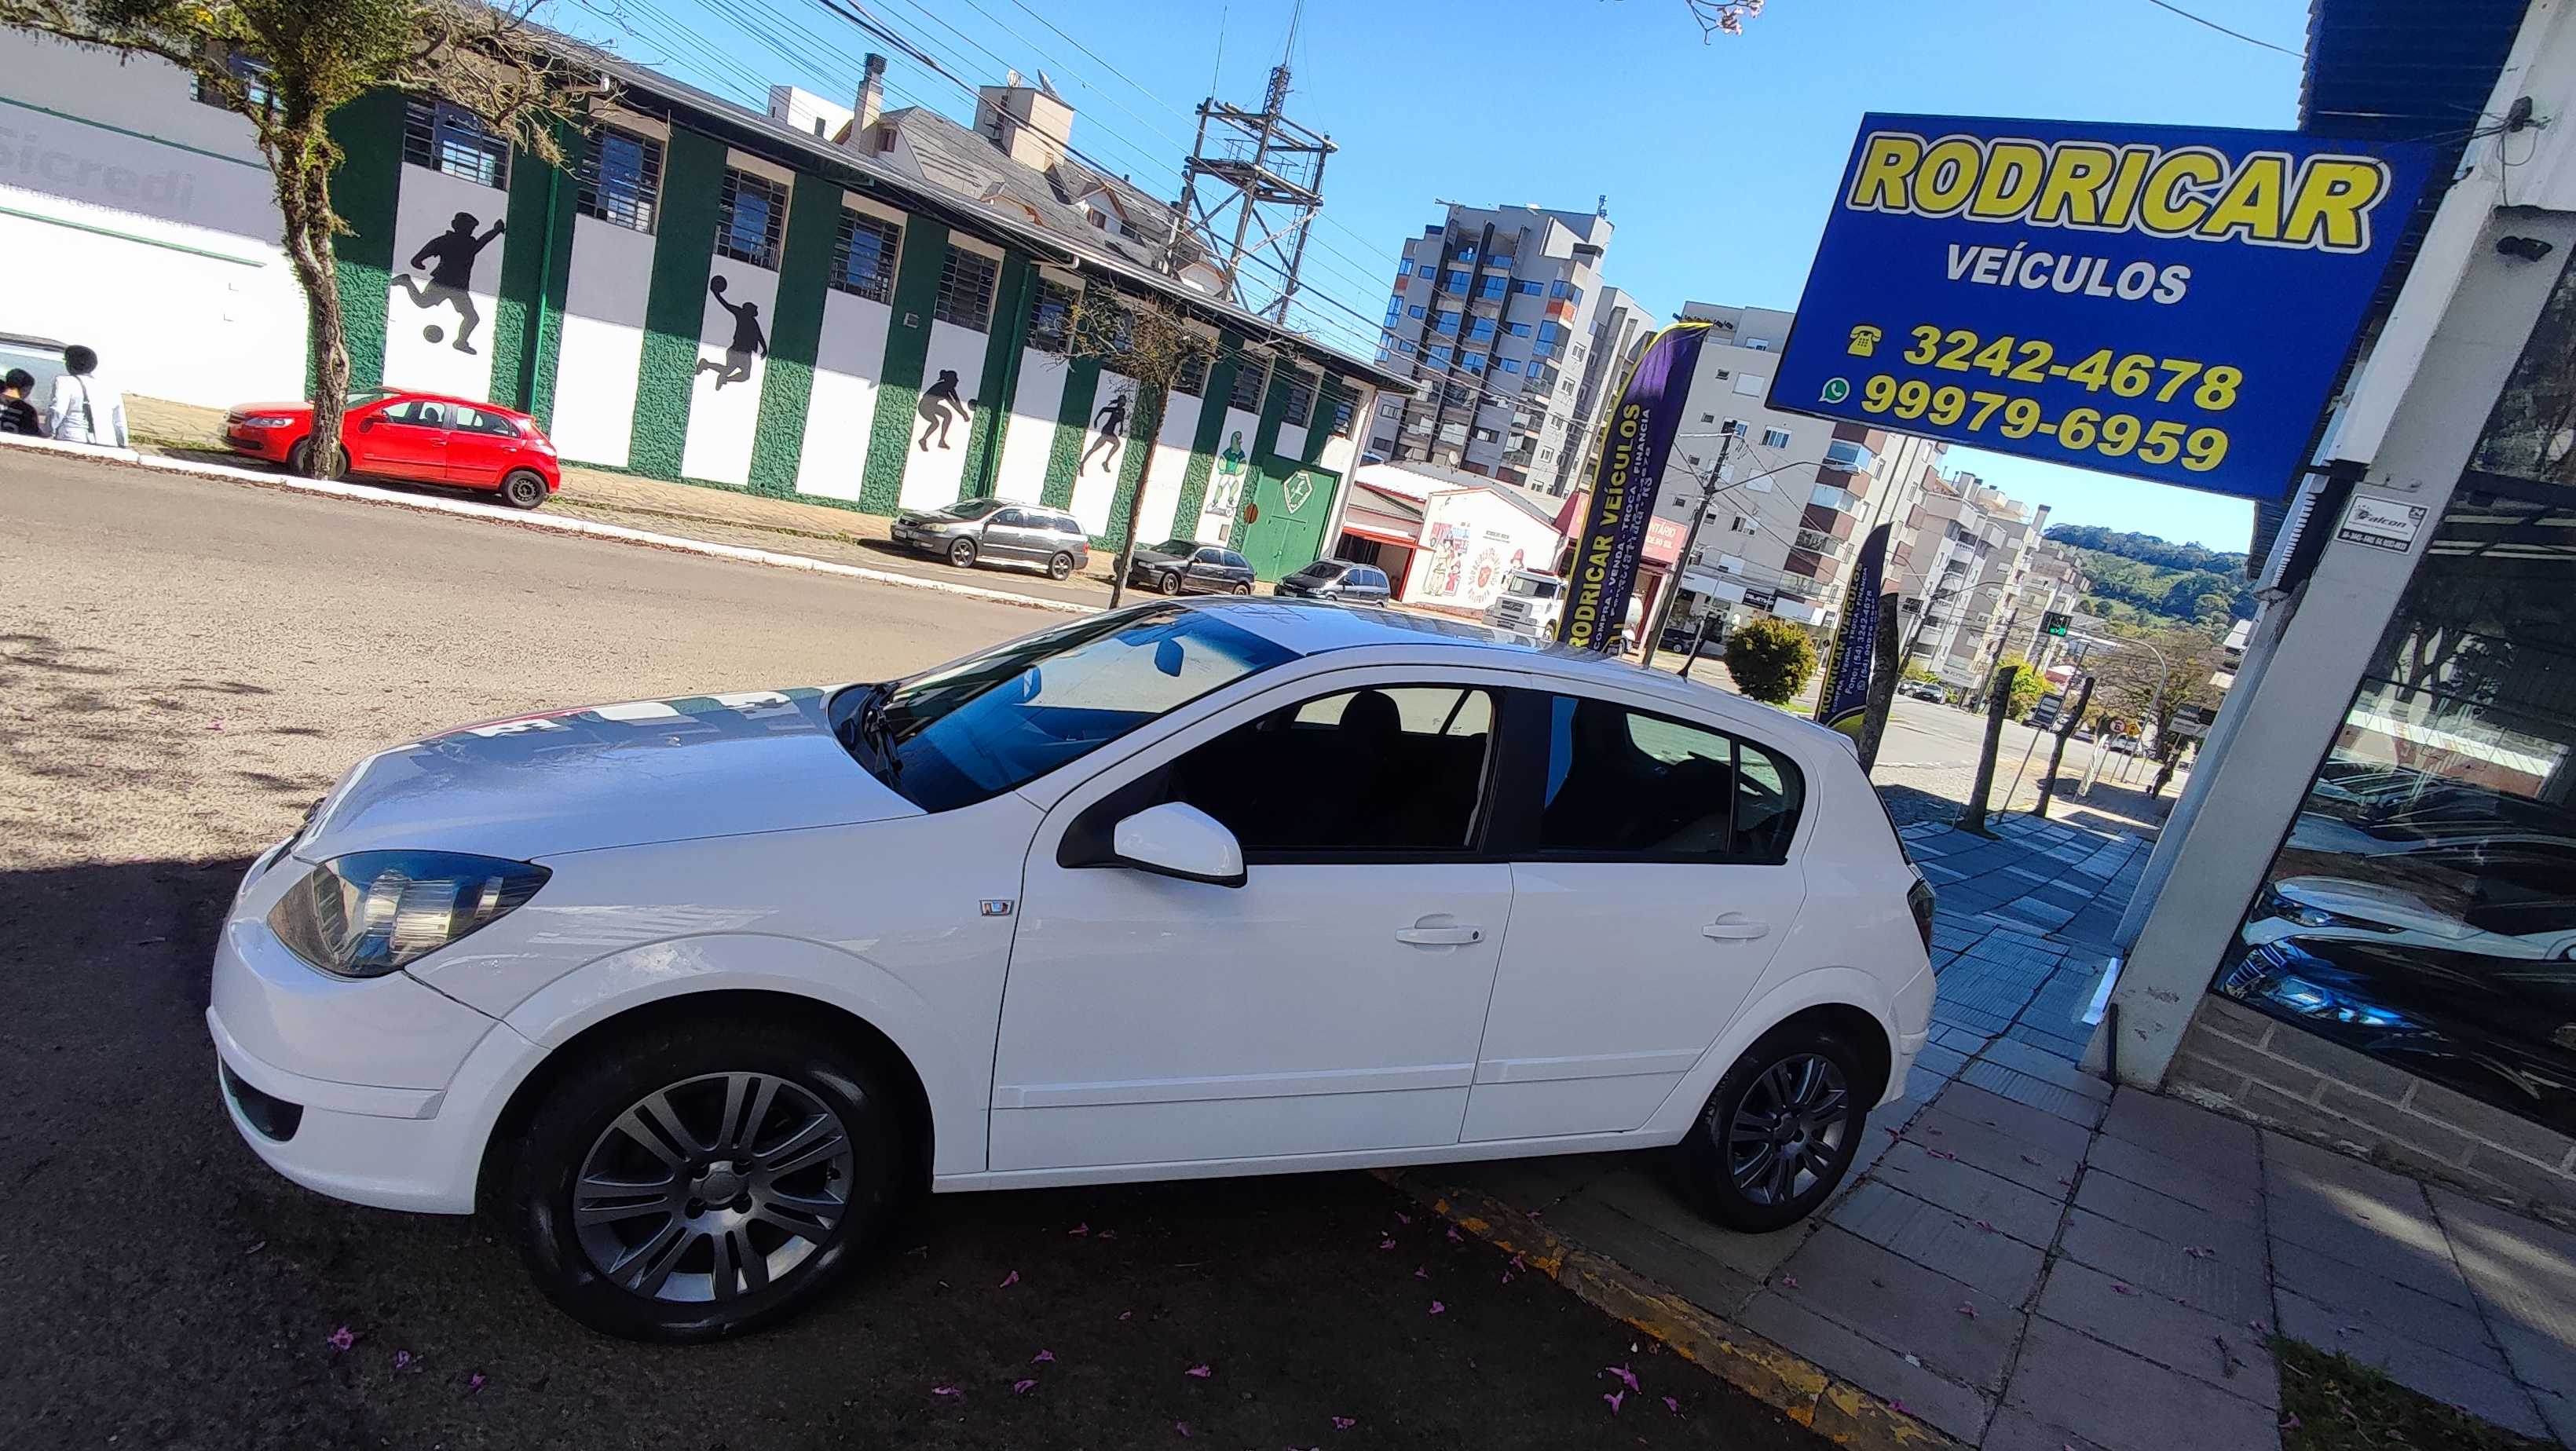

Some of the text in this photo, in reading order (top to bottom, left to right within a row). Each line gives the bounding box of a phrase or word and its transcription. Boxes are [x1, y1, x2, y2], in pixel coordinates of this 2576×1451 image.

[1851, 132, 2385, 251] RODRICAR
[1946, 240, 2193, 305] VEÍCULOS
[1903, 323, 2244, 411] 3242-4678
[1860, 373, 2230, 473] 99979-6959
[1568, 535, 1614, 649] RODRICAR
[1599, 404, 1641, 526] VEÍCULOS
[1593, 596, 1612, 650] COMPRA
[1608, 542, 1625, 587] VENDA
[1621, 485, 1637, 532] TROCA
[1633, 408, 1651, 475] FINANCIA
